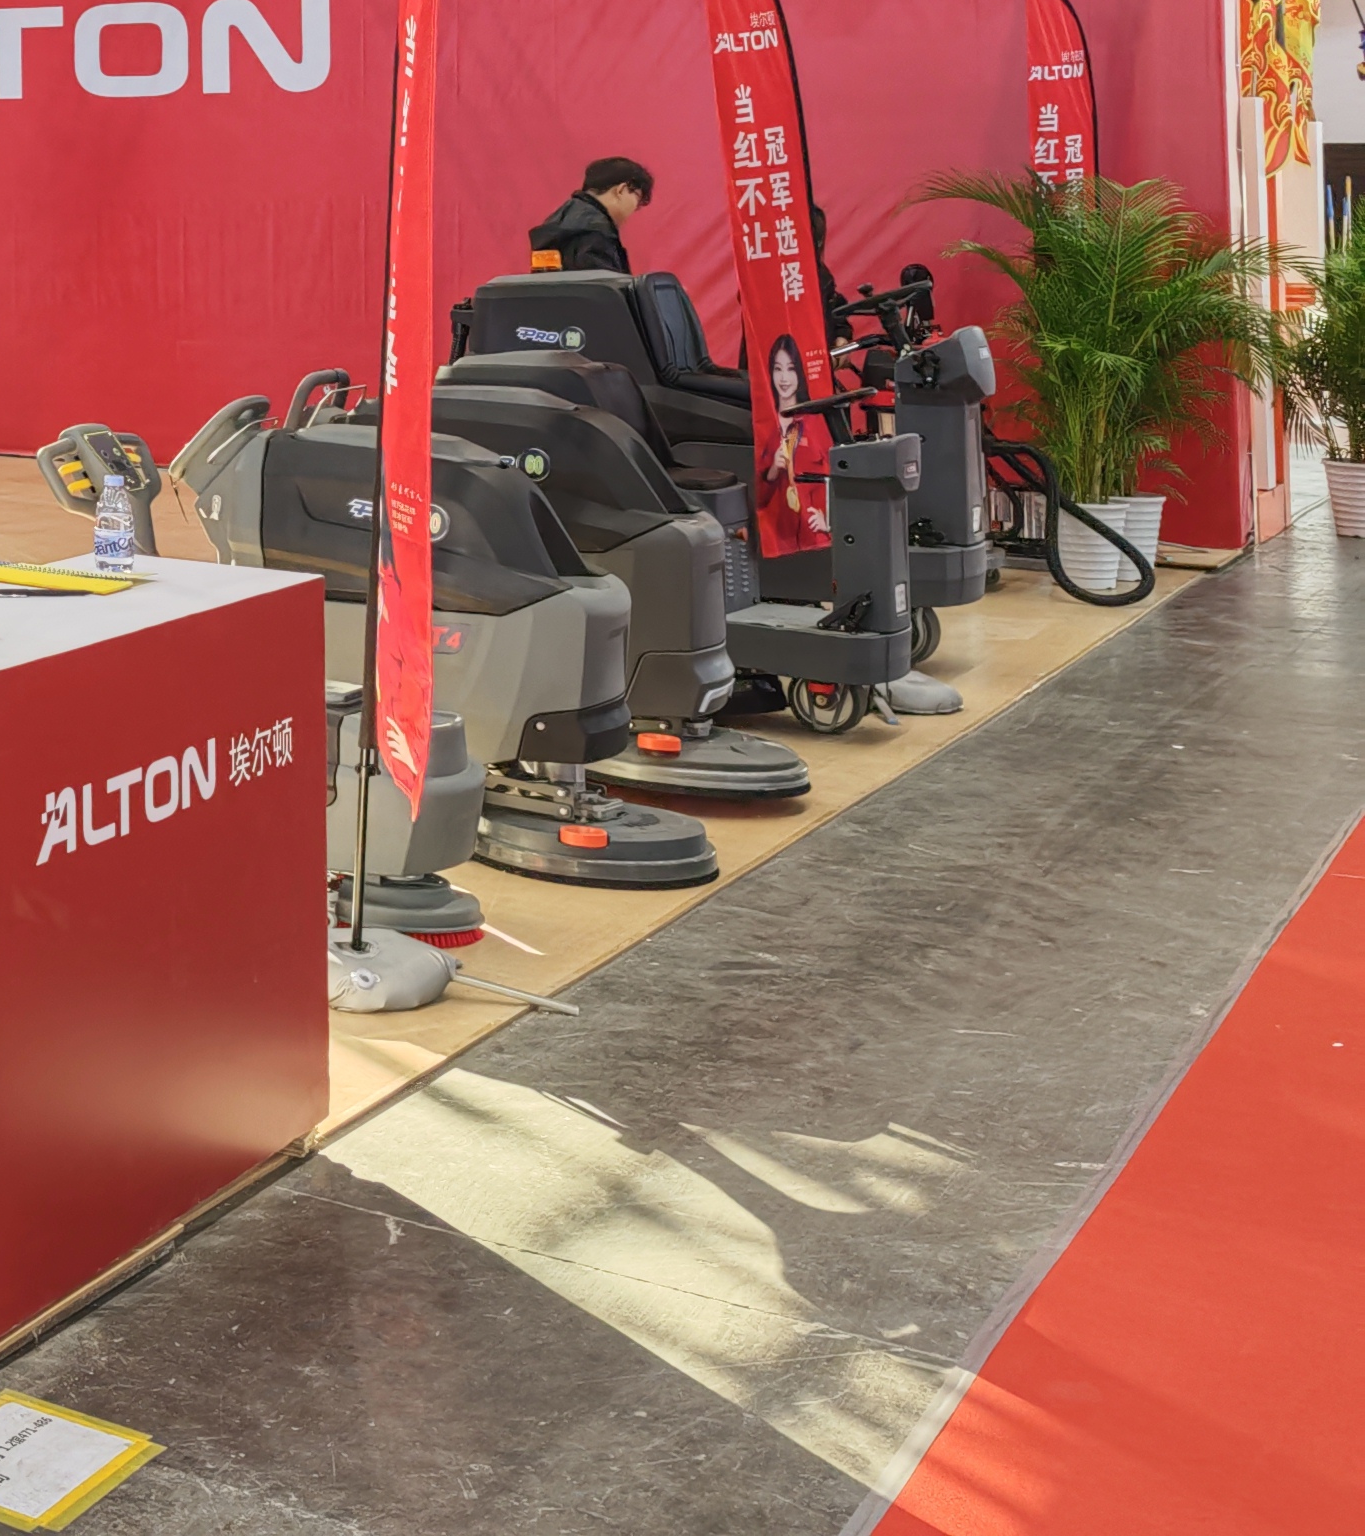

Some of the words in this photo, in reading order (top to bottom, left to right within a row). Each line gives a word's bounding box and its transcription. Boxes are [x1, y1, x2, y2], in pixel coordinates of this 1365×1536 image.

[714, 28, 778, 54] ALTON
[1028, 63, 1084, 81] ALTON
[733, 83, 771, 262] 当红不让
[764, 126, 805, 303] 冠军选择
[516, 326, 559, 344] PRO
[36, 737, 216, 866] ALTON
[229, 717, 294, 787] 埃尔顿
